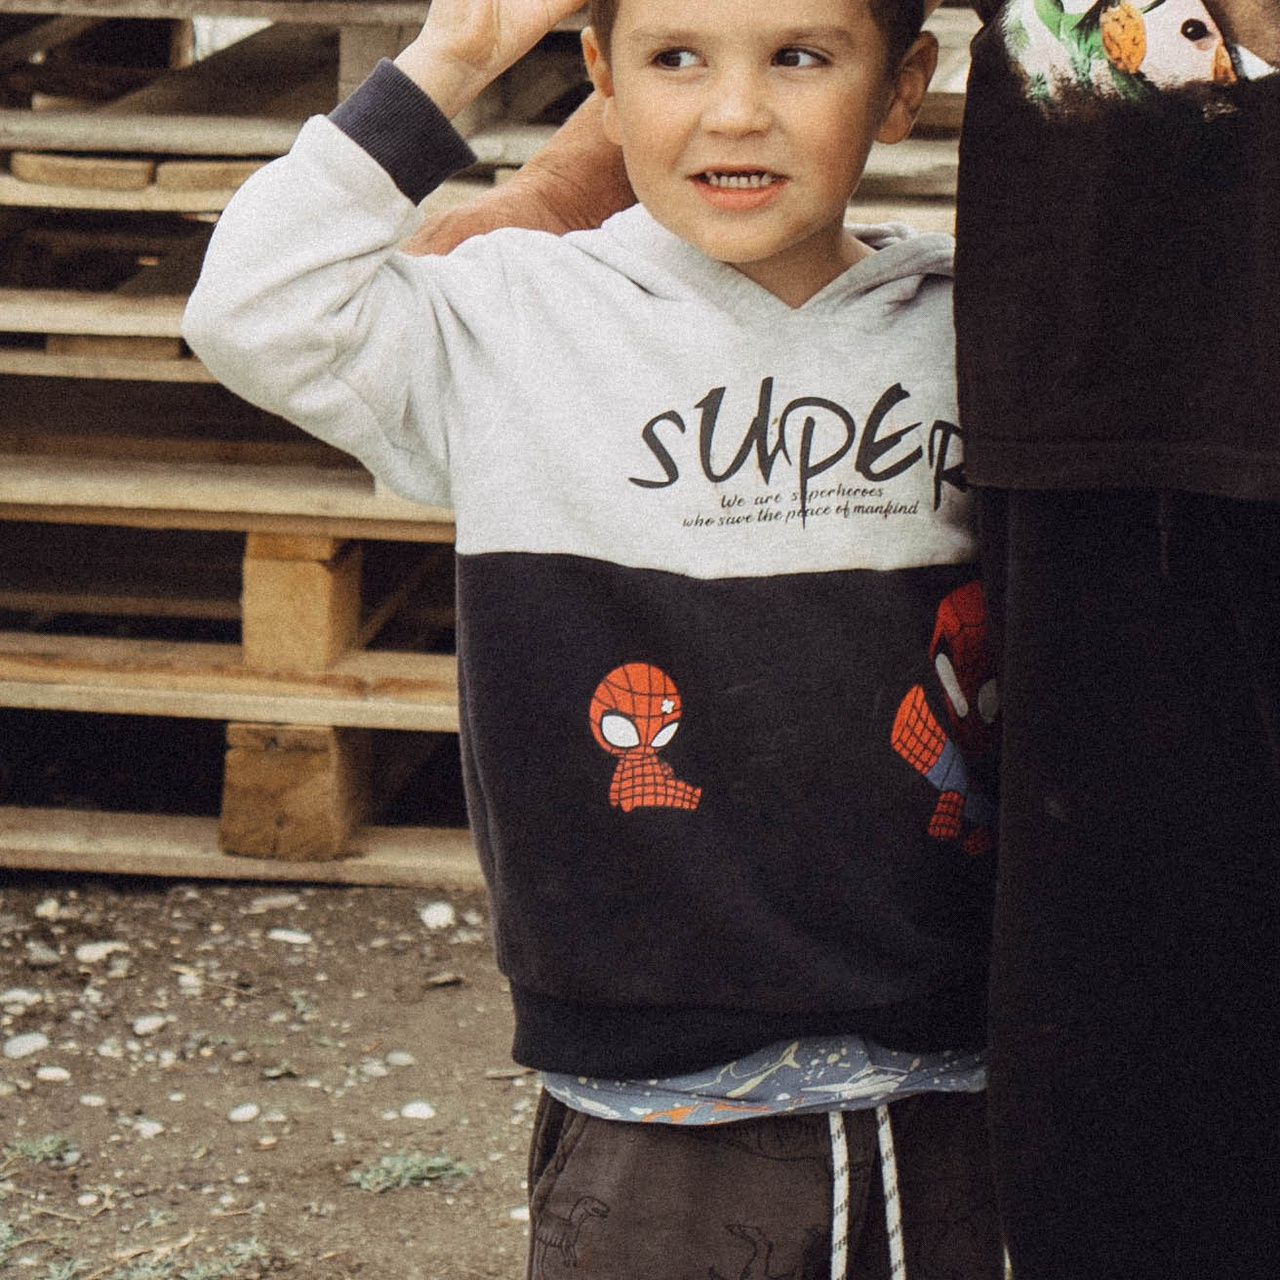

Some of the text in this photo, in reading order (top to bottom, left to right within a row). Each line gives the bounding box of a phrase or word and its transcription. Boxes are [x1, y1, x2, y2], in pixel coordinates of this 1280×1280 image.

[628, 376, 967, 529] SUPER
[721, 484, 884, 508] We are sperheroes
[682, 512, 715, 527] who
[718, 513, 752, 526] save
[757, 507, 783, 522] the
[835, 500, 850, 519] of
[853, 500, 919, 519] mankind
